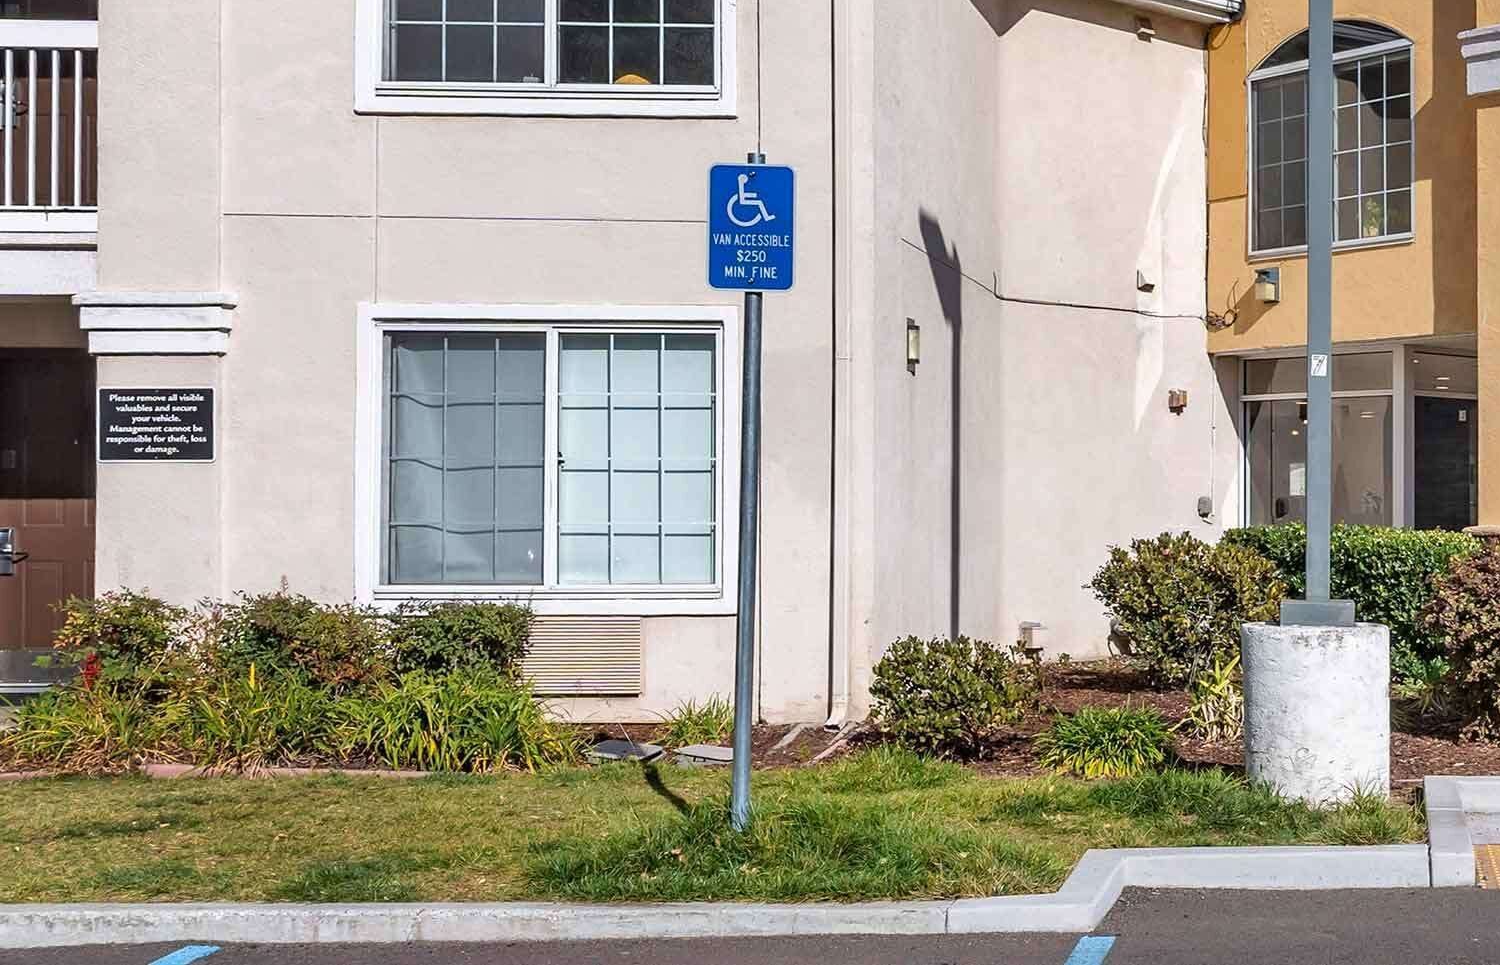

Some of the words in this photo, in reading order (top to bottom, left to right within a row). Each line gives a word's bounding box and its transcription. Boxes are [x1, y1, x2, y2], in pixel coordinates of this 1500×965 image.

[712, 233, 731, 245] VAN
[734, 234, 791, 247] ACCESSIBLE
[736, 249, 767, 263] $250
[724, 266, 748, 278] MIN.
[752, 266, 778, 279] FINE
[109, 393, 135, 402] Please
[167, 393, 178, 402] all
[179, 393, 204, 402] visible
[115, 404, 153, 412] valuables
[154, 404, 171, 412] and
[131, 416, 150, 425] your
[151, 414, 182, 422] vehicle.
[109, 425, 162, 435] Management
[163, 425, 192, 433] cannot
[192, 424, 203, 433] be
[105, 434, 152, 445] responsible
[153, 434, 166, 443] for
[167, 434, 190, 444] theft,
[190, 434, 207, 443] loss
[145, 445, 180, 455] damage.
